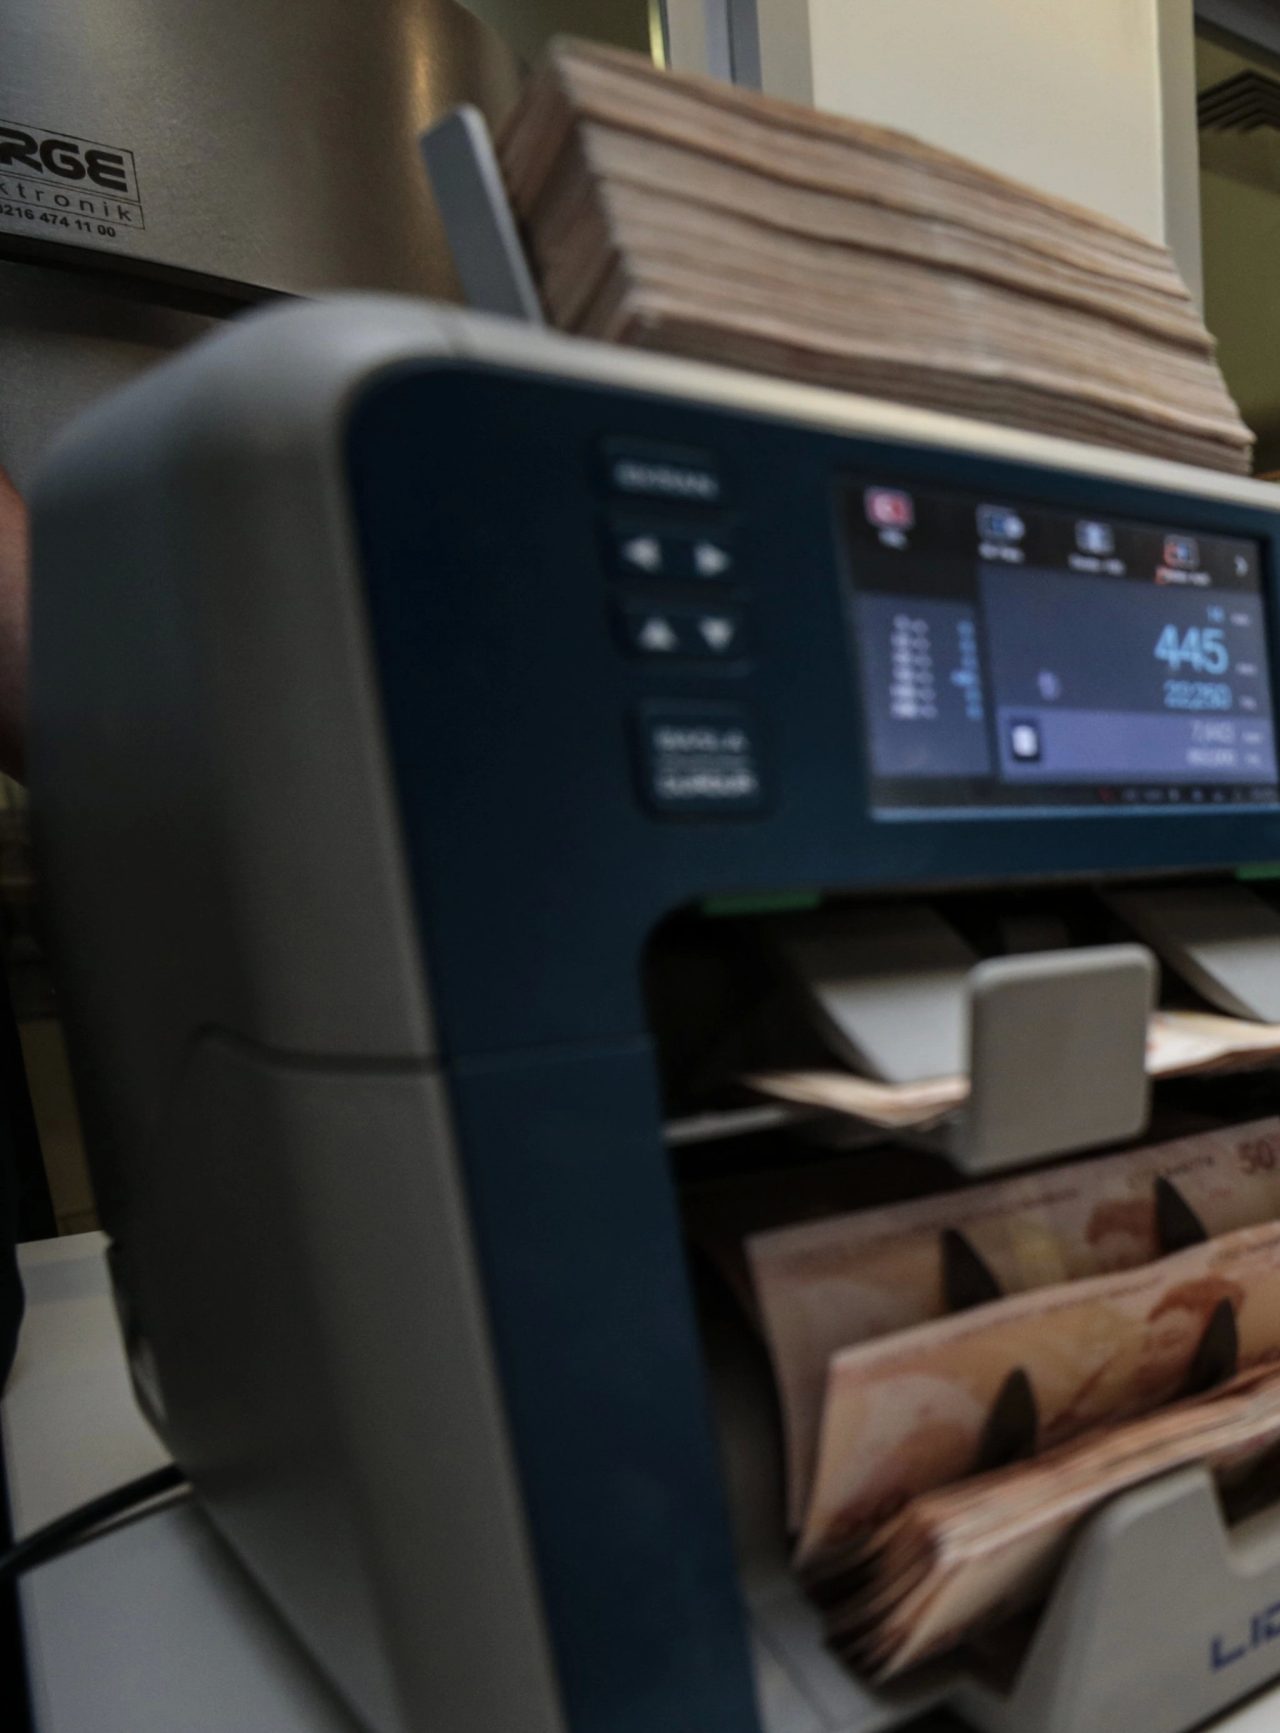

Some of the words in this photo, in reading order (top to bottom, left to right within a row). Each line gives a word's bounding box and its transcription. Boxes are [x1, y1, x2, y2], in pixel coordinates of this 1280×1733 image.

[40, 212, 69, 227] 474
[75, 220, 91, 232] 11
[97, 225, 116, 237] 00
[1154, 623, 1229, 675] 445
[1238, 1138, 1276, 1174] 50
